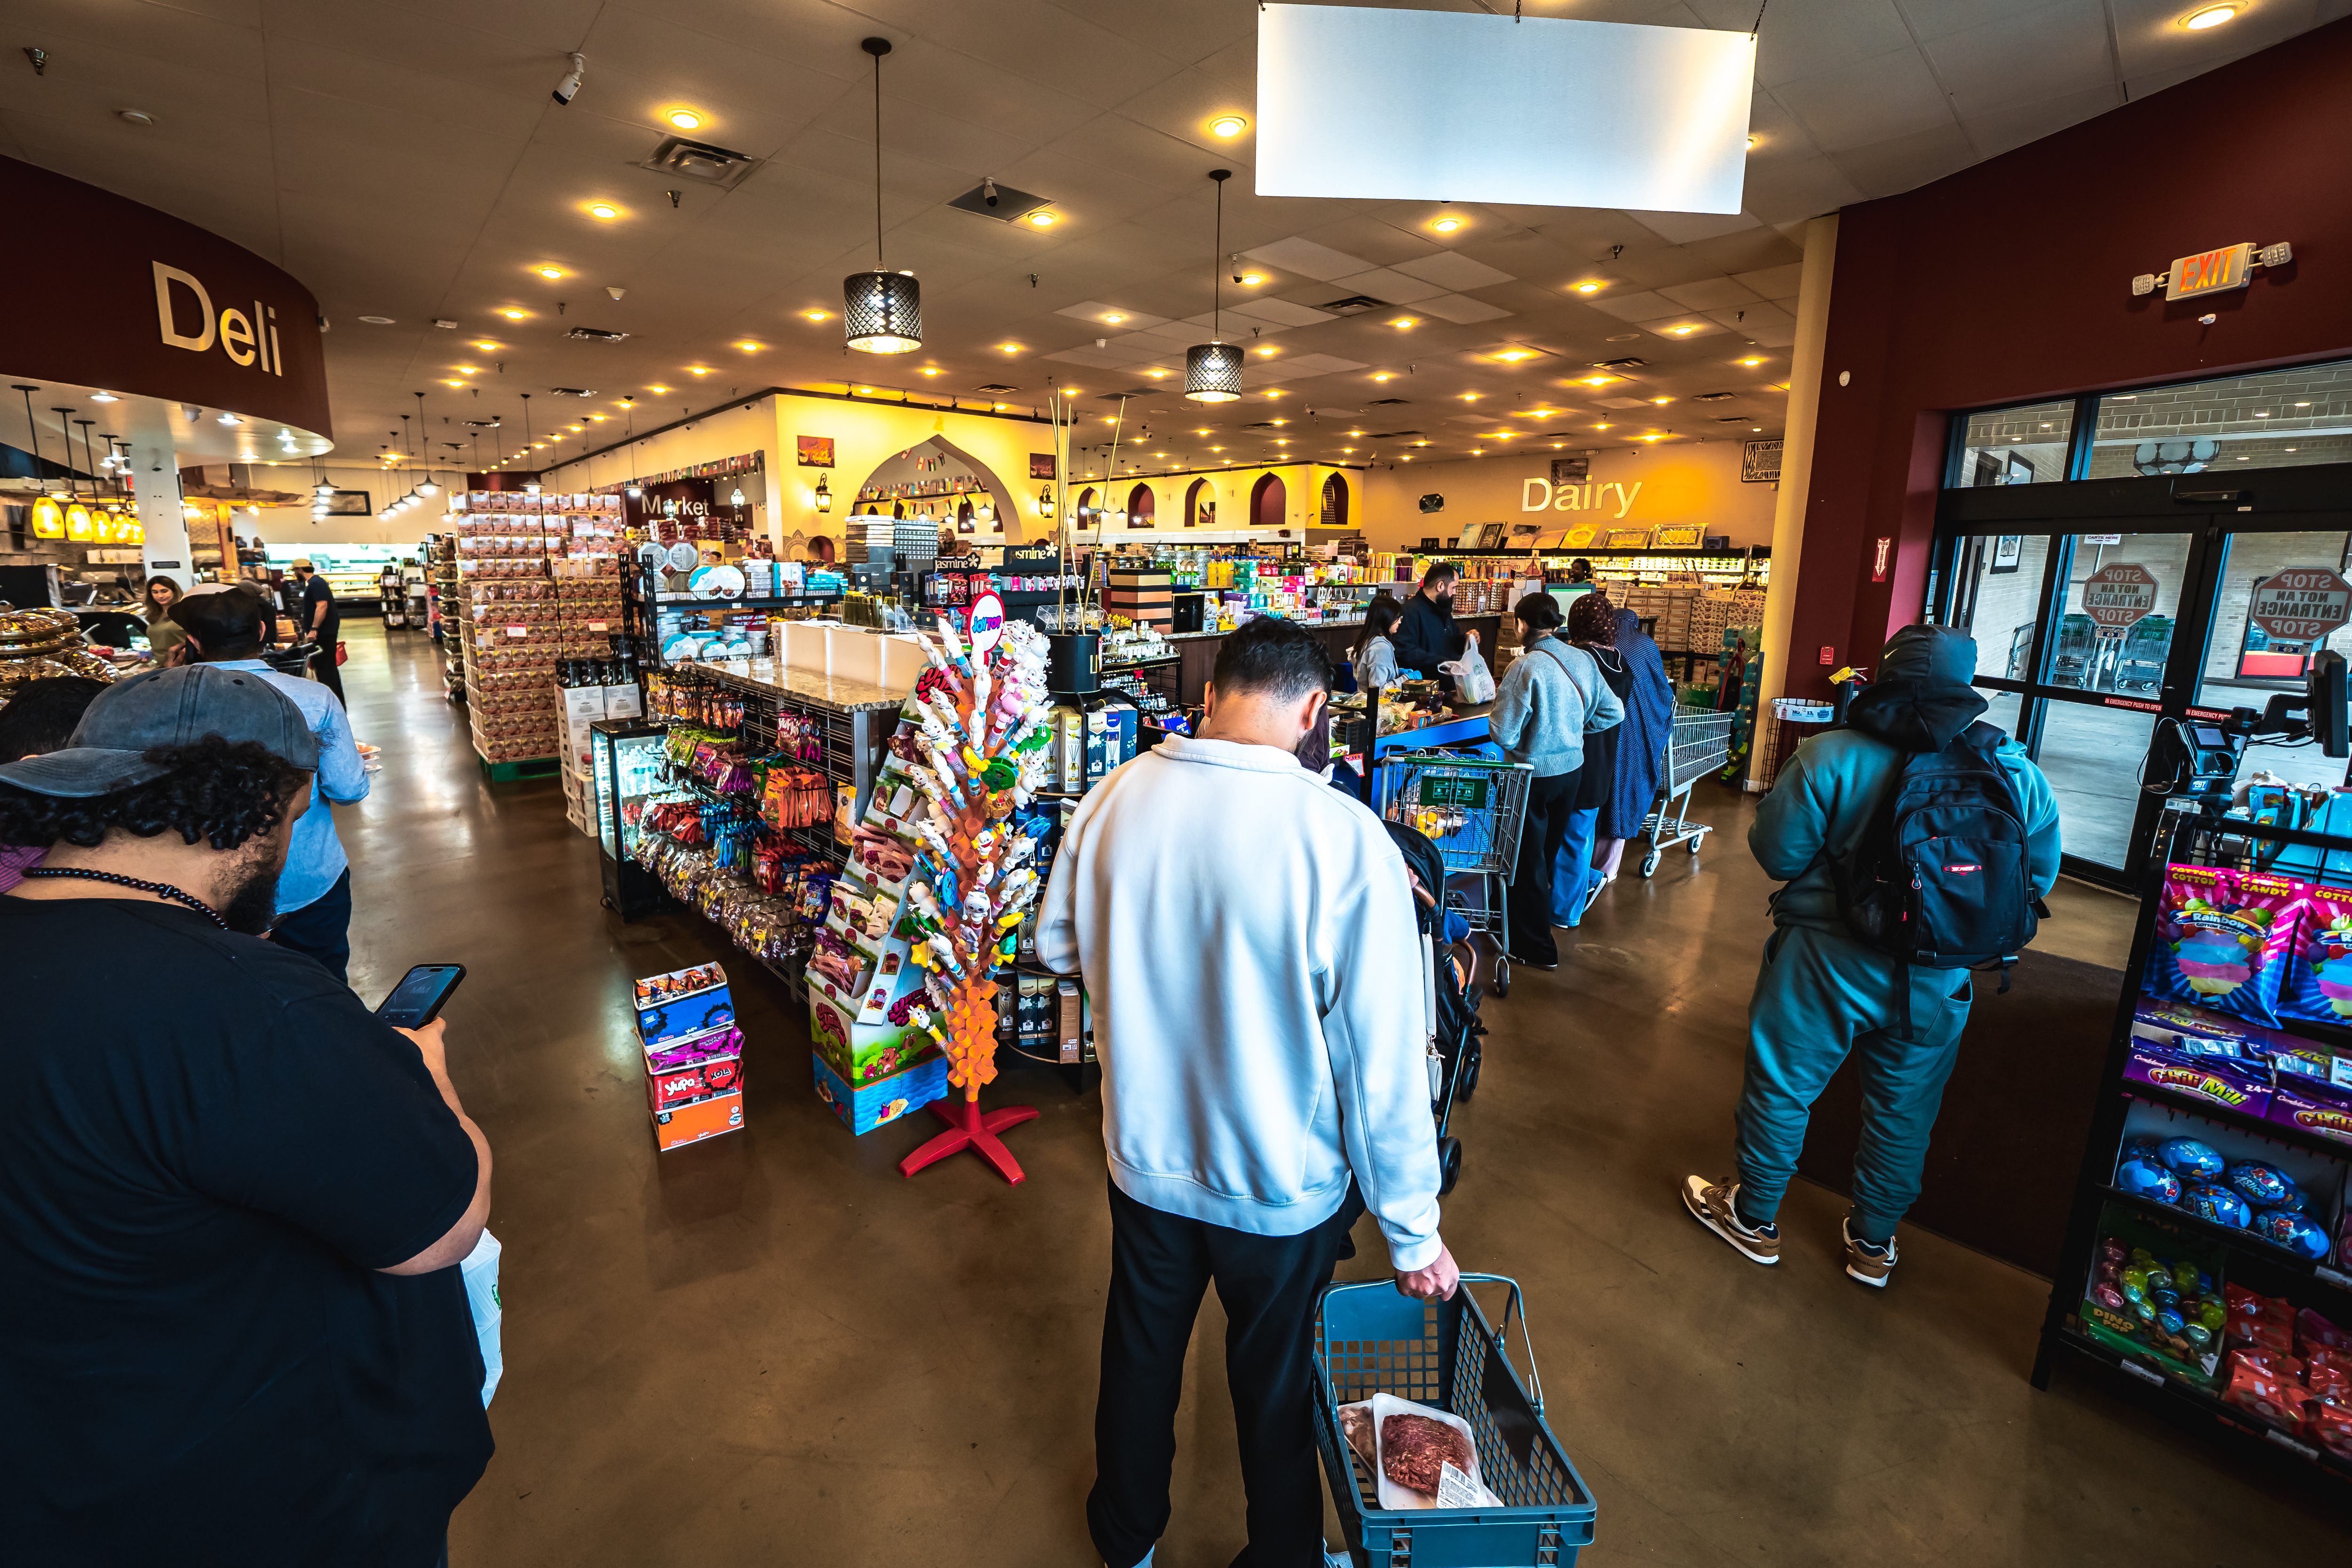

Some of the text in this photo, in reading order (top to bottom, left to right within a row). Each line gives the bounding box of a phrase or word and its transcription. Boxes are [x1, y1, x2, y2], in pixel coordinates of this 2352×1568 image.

[2179, 248, 2237, 293] EXIT
[152, 260, 282, 377] Deli
[641, 494, 709, 516] Mrket
[1522, 475, 1643, 519] Dairy
[2191, 710, 2218, 718] EMERGENCY
[2172, 873, 2290, 897] COTTON CANDY
[2193, 913, 2248, 929] Rainbow
[2219, 925, 2241, 934] CANDY
[710, 1068, 731, 1081] KOLA
[2150, 1068, 2201, 1089] Chili
[2201, 1080, 2248, 1106] Mili
[2246, 1084, 2261, 1093] 24
[2094, 1308, 2134, 1330] DINO
[2103, 1319, 2129, 1332] POP
